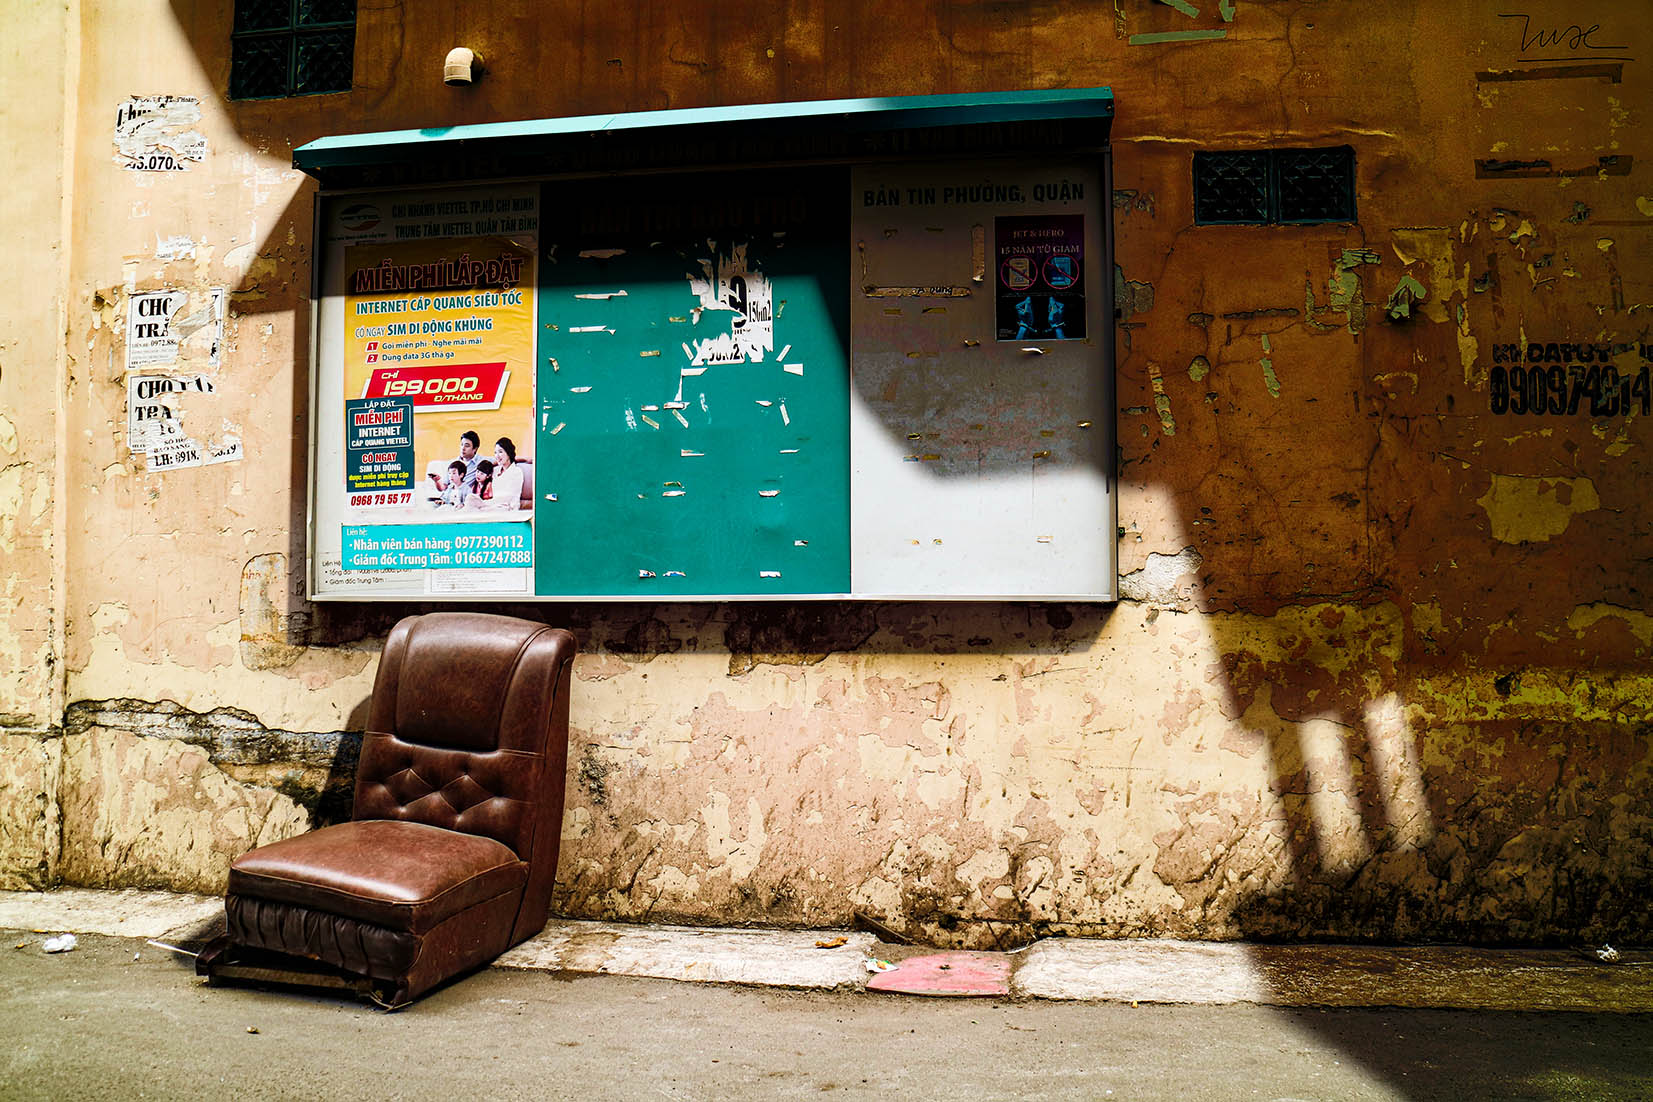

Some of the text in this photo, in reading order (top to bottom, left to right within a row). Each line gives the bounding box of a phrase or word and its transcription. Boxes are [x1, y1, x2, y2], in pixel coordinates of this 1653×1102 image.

[907, 188, 936, 205] TIN
[437, 201, 468, 216] VIETTEL
[512, 197, 535, 211] MINH
[395, 223, 421, 239] TRUNG
[442, 220, 473, 235] VIETTEL
[356, 258, 407, 292] MIỄN
[408, 258, 447, 289] PHÍ
[485, 252, 524, 290] ĐẶT
[356, 300, 408, 315] INTERNET
[433, 295, 472, 311] QUANG
[474, 291, 499, 307] SIÊU
[501, 288, 522, 305] TỐC
[366, 326, 386, 337] NGAY
[387, 322, 407, 336] SIM
[409, 322, 420, 334] DI
[422, 319, 452, 337] ĐỘNG
[454, 316, 493, 332] KHỦNG
[433, 339, 452, 348] Nghe
[403, 352, 419, 360] data
[383, 377, 479, 396] 199.000
[384, 408, 404, 424] PHÍ
[359, 426, 401, 438] INTERNET
[365, 438, 385, 446] QUANG
[386, 437, 409, 445] VIETTEL
[375, 452, 397, 463] NGAY
[359, 465, 373, 473] SIM
[374, 464, 381, 472] DI
[351, 492, 411, 506] 0968 79 55 77
[353, 537, 379, 551] Nhân
[381, 537, 401, 550] viên
[404, 536, 423, 550] bán
[455, 535, 524, 550] 0977390112
[353, 553, 379, 566] Giám
[380, 552, 397, 566] đốc
[398, 553, 427, 568] Trung
[455, 550, 531, 564] 01667247888
[358, 576, 372, 585] Trung
